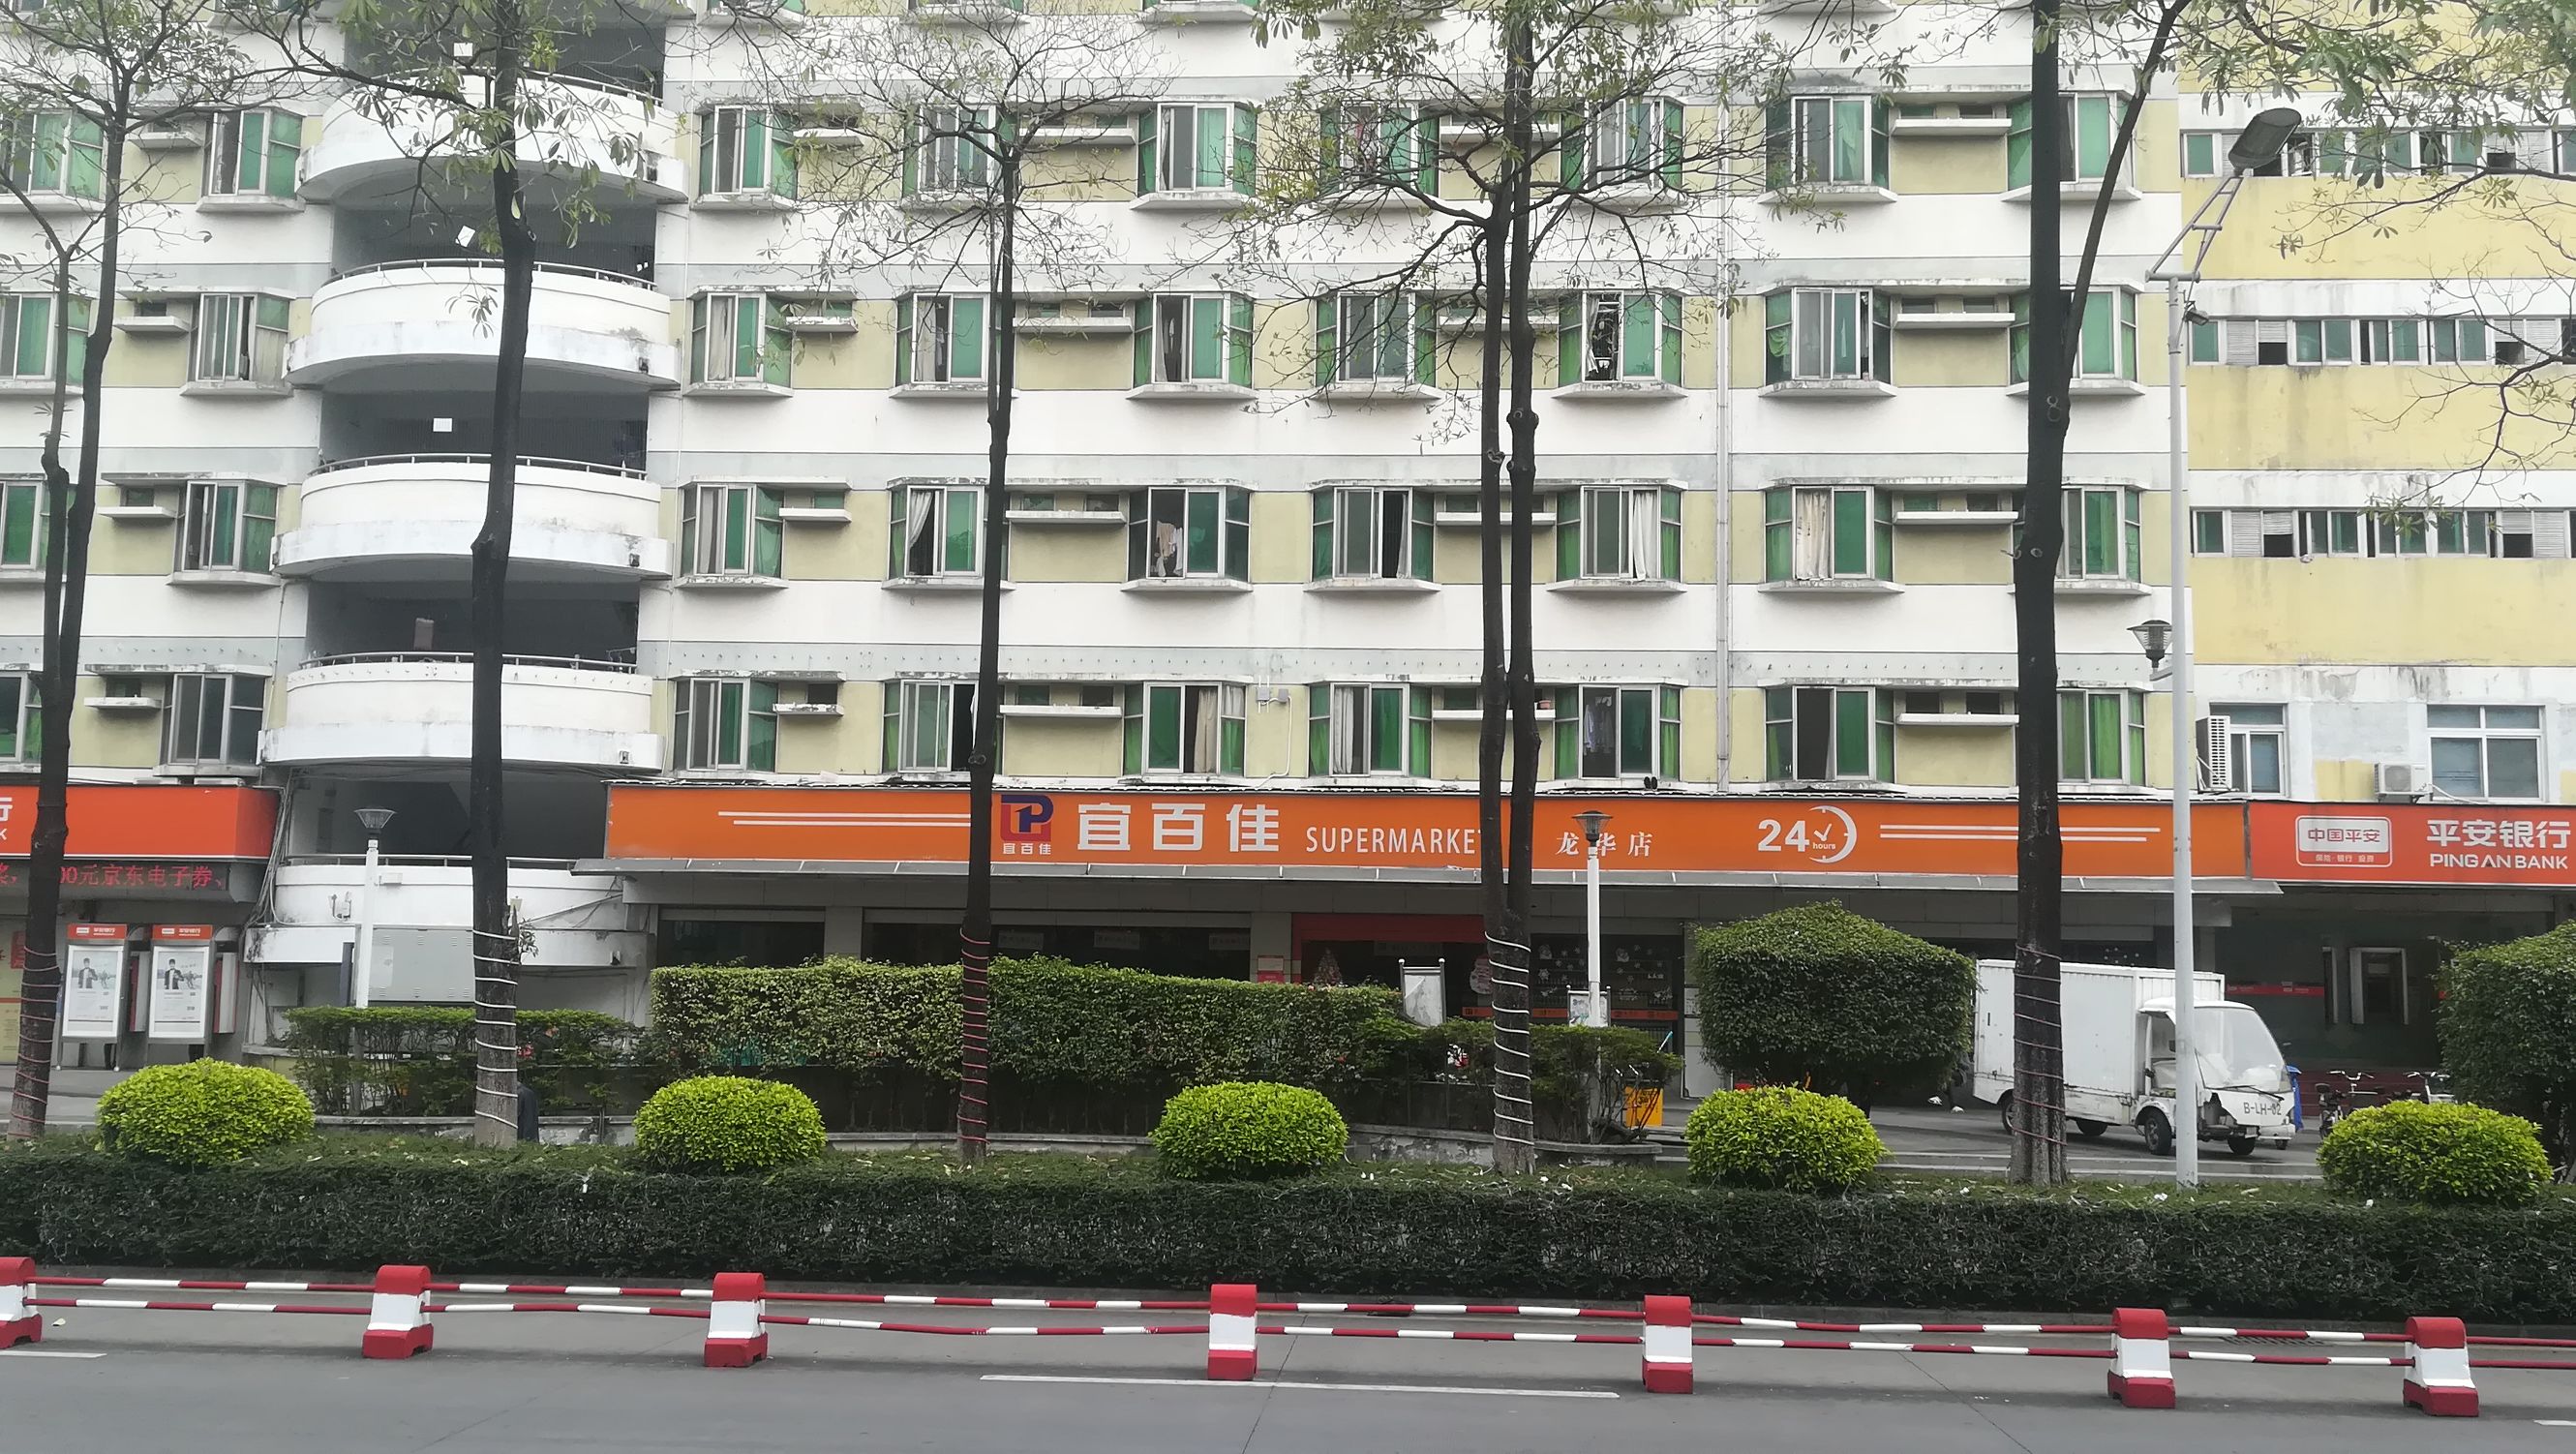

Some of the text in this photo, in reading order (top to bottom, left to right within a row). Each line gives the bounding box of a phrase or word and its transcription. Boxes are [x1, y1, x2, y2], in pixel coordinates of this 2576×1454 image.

[1077, 802, 1279, 852] 宜百佳
[1758, 819, 1810, 853] 24
[2308, 829, 2380, 842] 中国平安
[2426, 818, 2571, 849] 平安银行
[1003, 842, 1052, 855] 宜百佳
[1306, 827, 1481, 854] SUPERMARKE
[1812, 839, 1836, 850] hours
[2515, 855, 2568, 869] BANK
